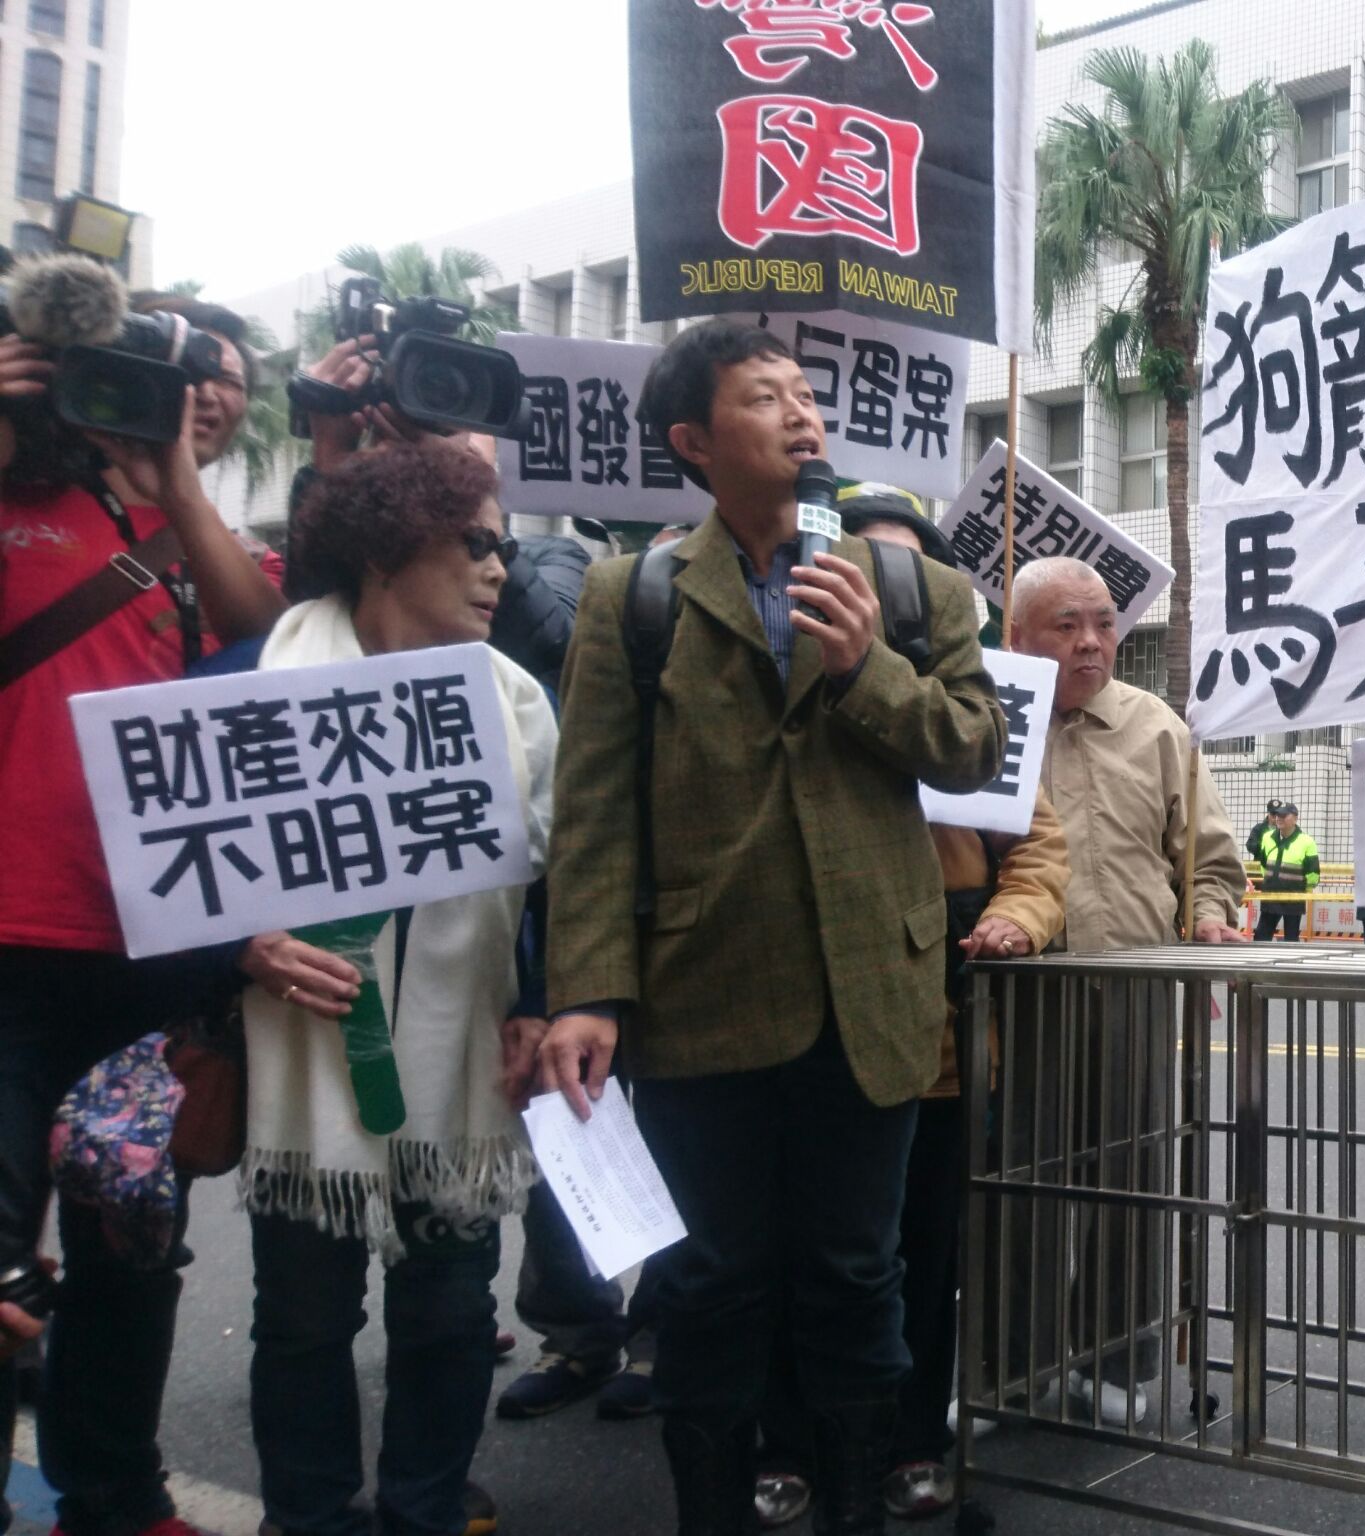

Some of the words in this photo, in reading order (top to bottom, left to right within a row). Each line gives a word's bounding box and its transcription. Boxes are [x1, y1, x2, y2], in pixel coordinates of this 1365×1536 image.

[758, 312, 954, 459] 巨蛋案
[980, 466, 1151, 612] 特別費
[112, 674, 482, 816] 財產來源
[139, 778, 504, 916] 不明案
